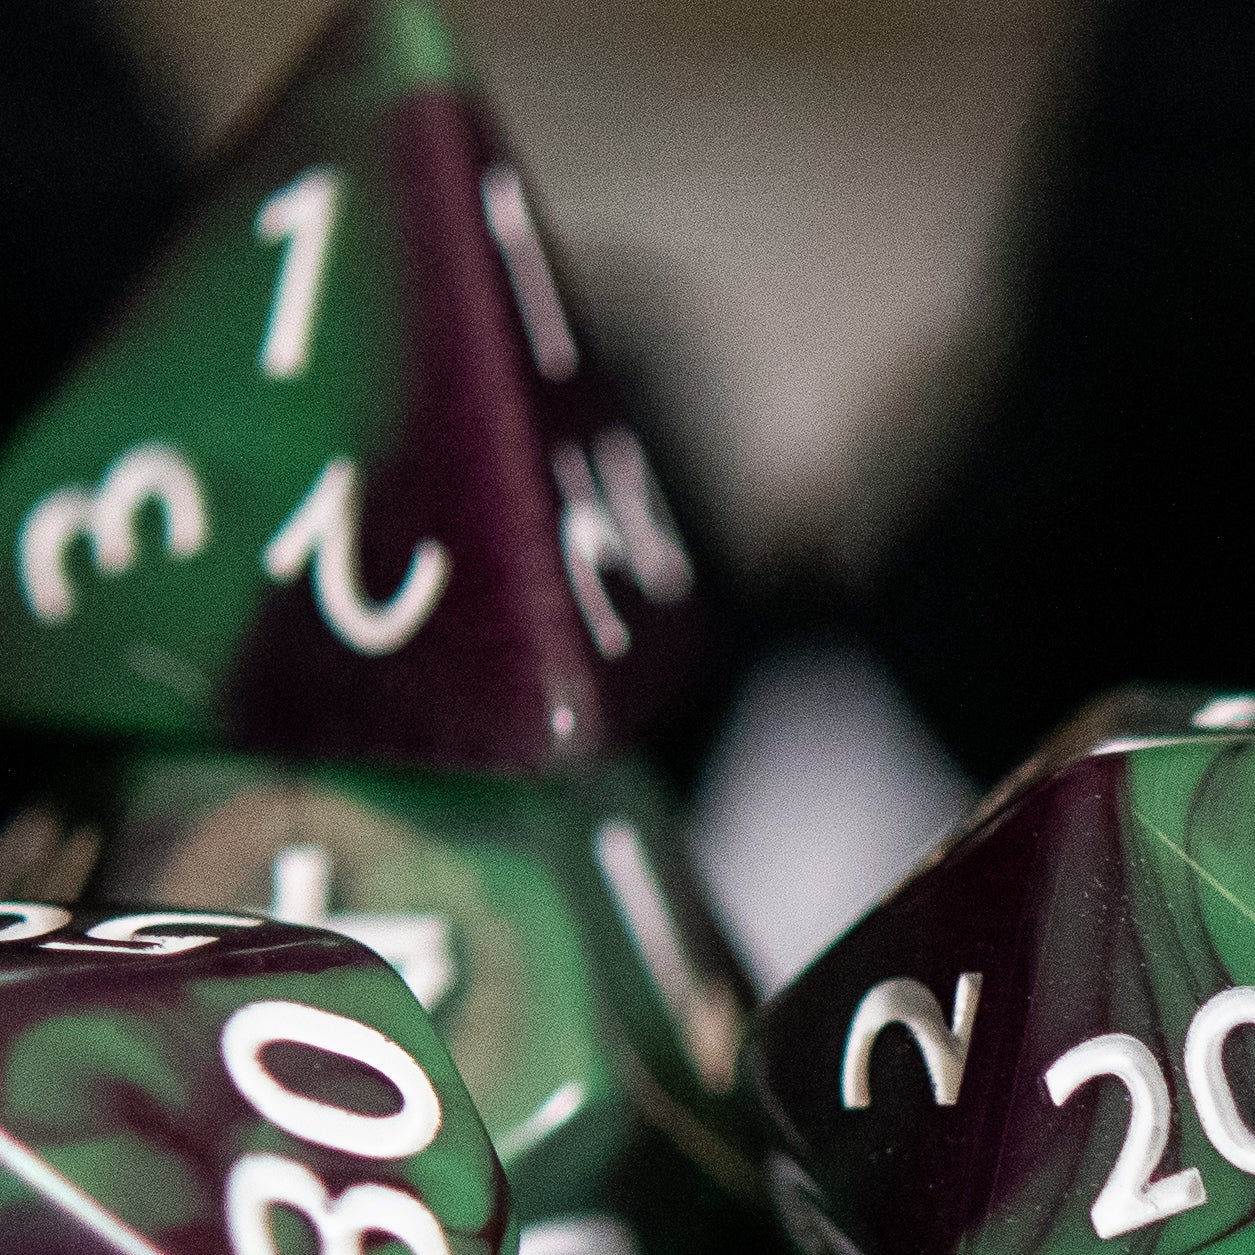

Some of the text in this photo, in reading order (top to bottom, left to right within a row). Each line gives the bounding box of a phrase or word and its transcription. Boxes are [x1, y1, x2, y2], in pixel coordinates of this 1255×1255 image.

[258, 168, 337, 378] 1
[20, 442, 208, 625] 3
[843, 976, 983, 1110] 2
